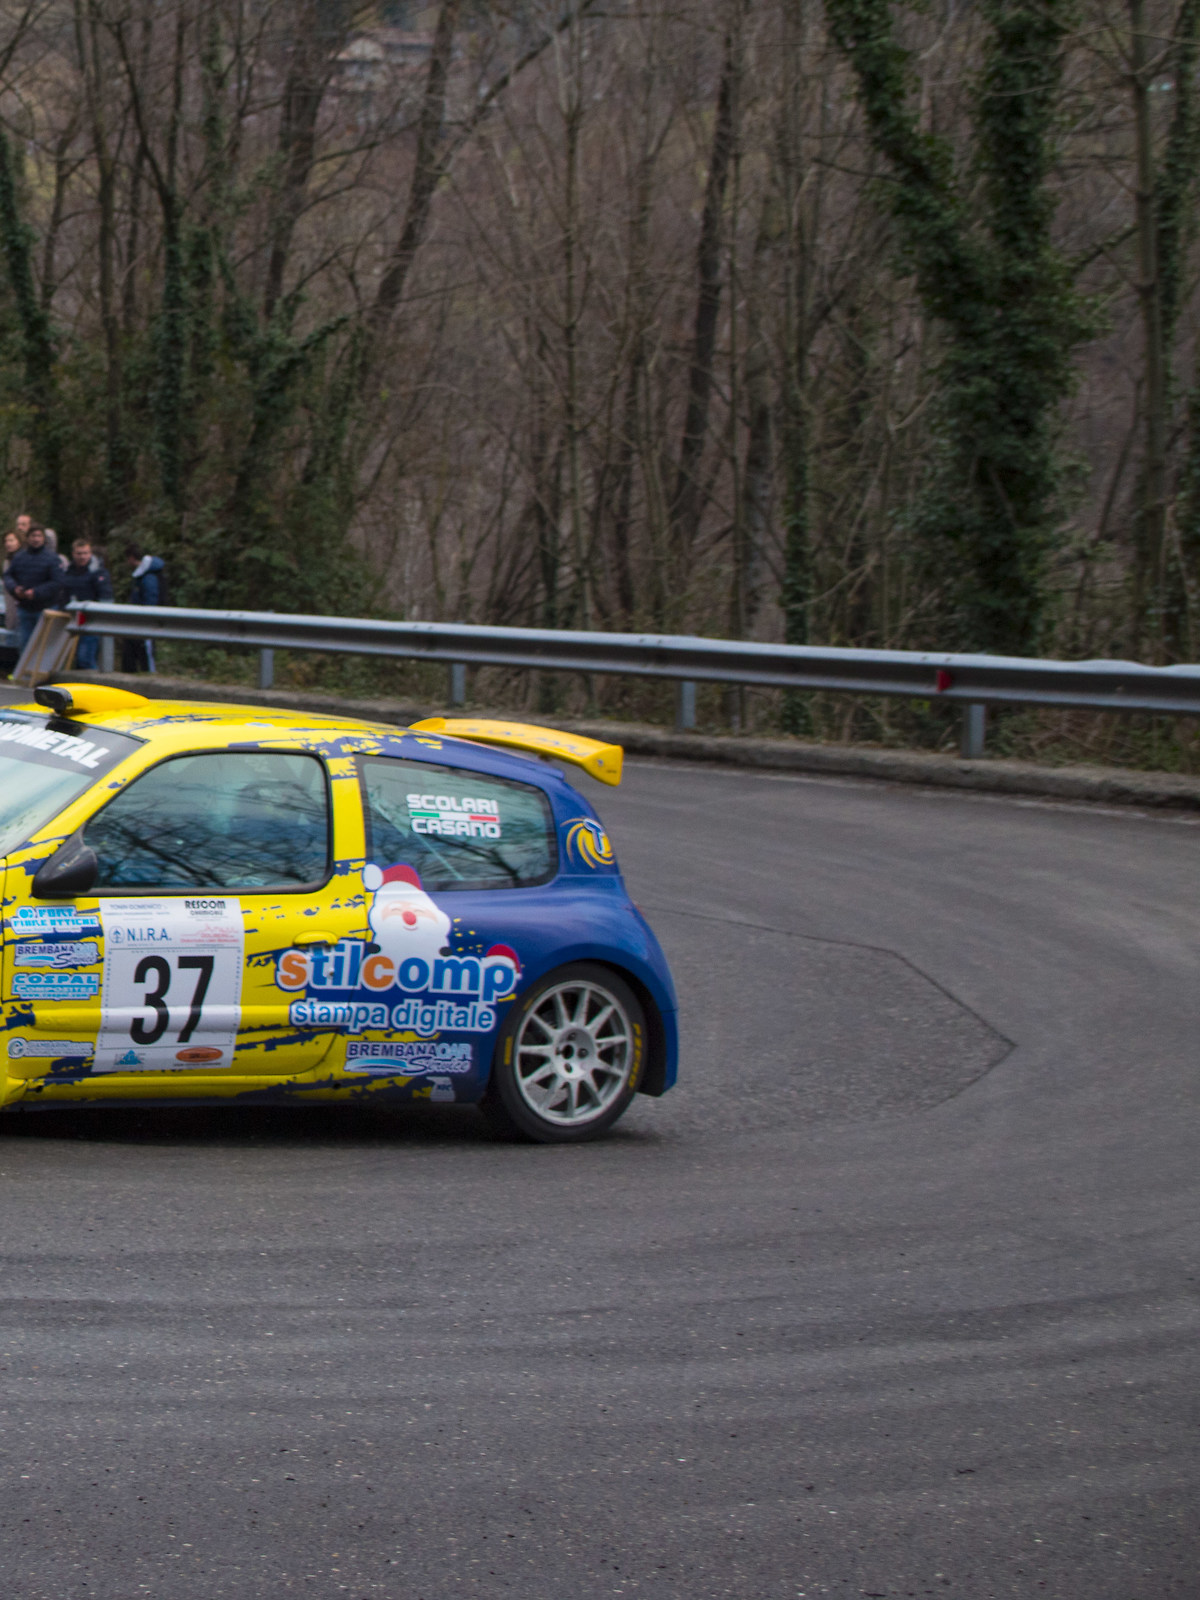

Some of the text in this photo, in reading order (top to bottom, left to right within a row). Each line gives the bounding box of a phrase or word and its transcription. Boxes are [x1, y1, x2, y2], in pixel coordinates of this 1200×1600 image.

[406, 793, 499, 814] SCOLARI
[410, 818, 501, 838] CASANO
[184, 900, 226, 909] RESCOM
[126, 927, 173, 942] N.I.R.A.
[14, 975, 98, 984] COSPAL
[277, 942, 515, 1002] stilcomp
[129, 955, 215, 1045] 37
[293, 1001, 494, 1033] stampa digitale
[402, 1057, 471, 1074] Service
